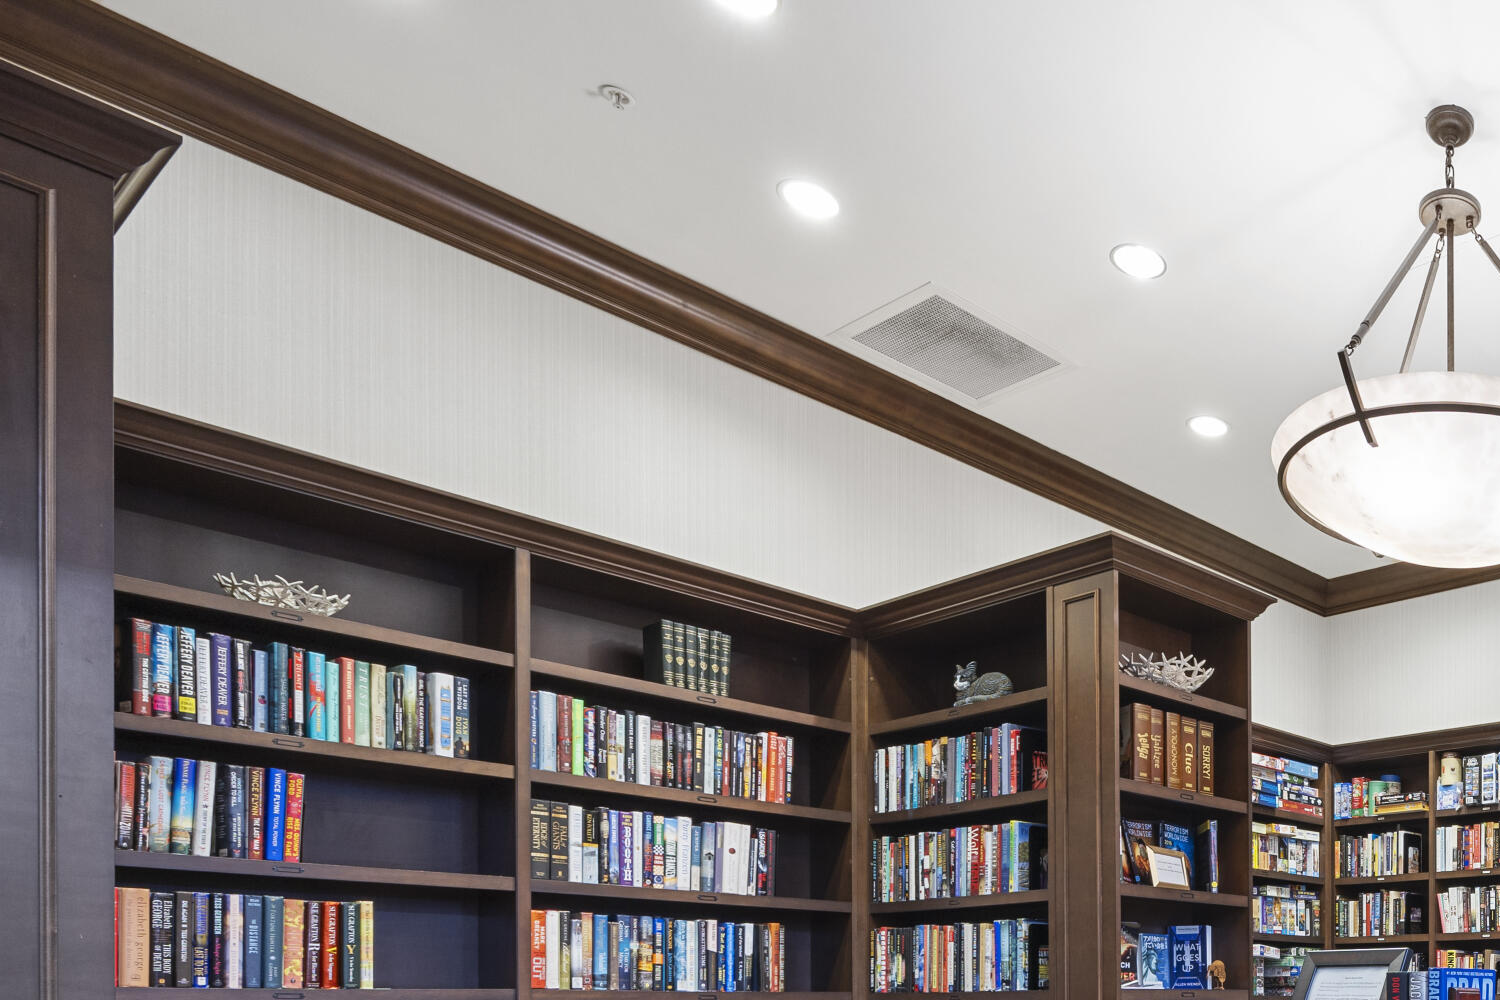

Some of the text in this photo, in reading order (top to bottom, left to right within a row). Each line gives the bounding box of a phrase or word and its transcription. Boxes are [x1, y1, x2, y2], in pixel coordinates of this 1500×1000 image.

[156, 632, 170, 694] JEFFERY DEAVER
[180, 630, 193, 696] JEFFERY DEAVER
[218, 645, 228, 706] JEFFERY DEAVER
[1137, 732, 1150, 760] Jenga
[1151, 734, 1163, 769] Yahtzee
[1184, 742, 1194, 774] Clue
[1202, 745, 1211, 779] SORRY!
[251, 771, 260, 816] VINCE FLYNN
[272, 773, 282, 816] VINCE FLYNN
[532, 816, 541, 850] ETERNITY
[541, 822, 550, 841] EDGE
[552, 821, 562, 850] GIANTS
[559, 825, 568, 843] FALL
[969, 827, 979, 856] Wolf
[1164, 823, 1189, 836] TERRORISM
[1164, 831, 1189, 843] WORLDWIDE
[624, 826, 633, 882] BOOTH
[152, 899, 162, 929] GEORGE
[164, 900, 173, 930] Elizabeth
[249, 923, 258, 954] DISTANCE
[309, 915, 320, 951] GRAFTON R
[326, 917, 338, 955] GRAFTON V
[347, 917, 356, 955] GRAFTON Y
[1175, 943, 1200, 951] WHAT
[152, 954, 161, 972] DEATH
[163, 943, 172, 975] THIS BODY
[533, 957, 543, 981] OUT
[1175, 954, 1200, 962] GOES
[1182, 964, 1194, 973] UP
[1391, 977, 1401, 994] DON
